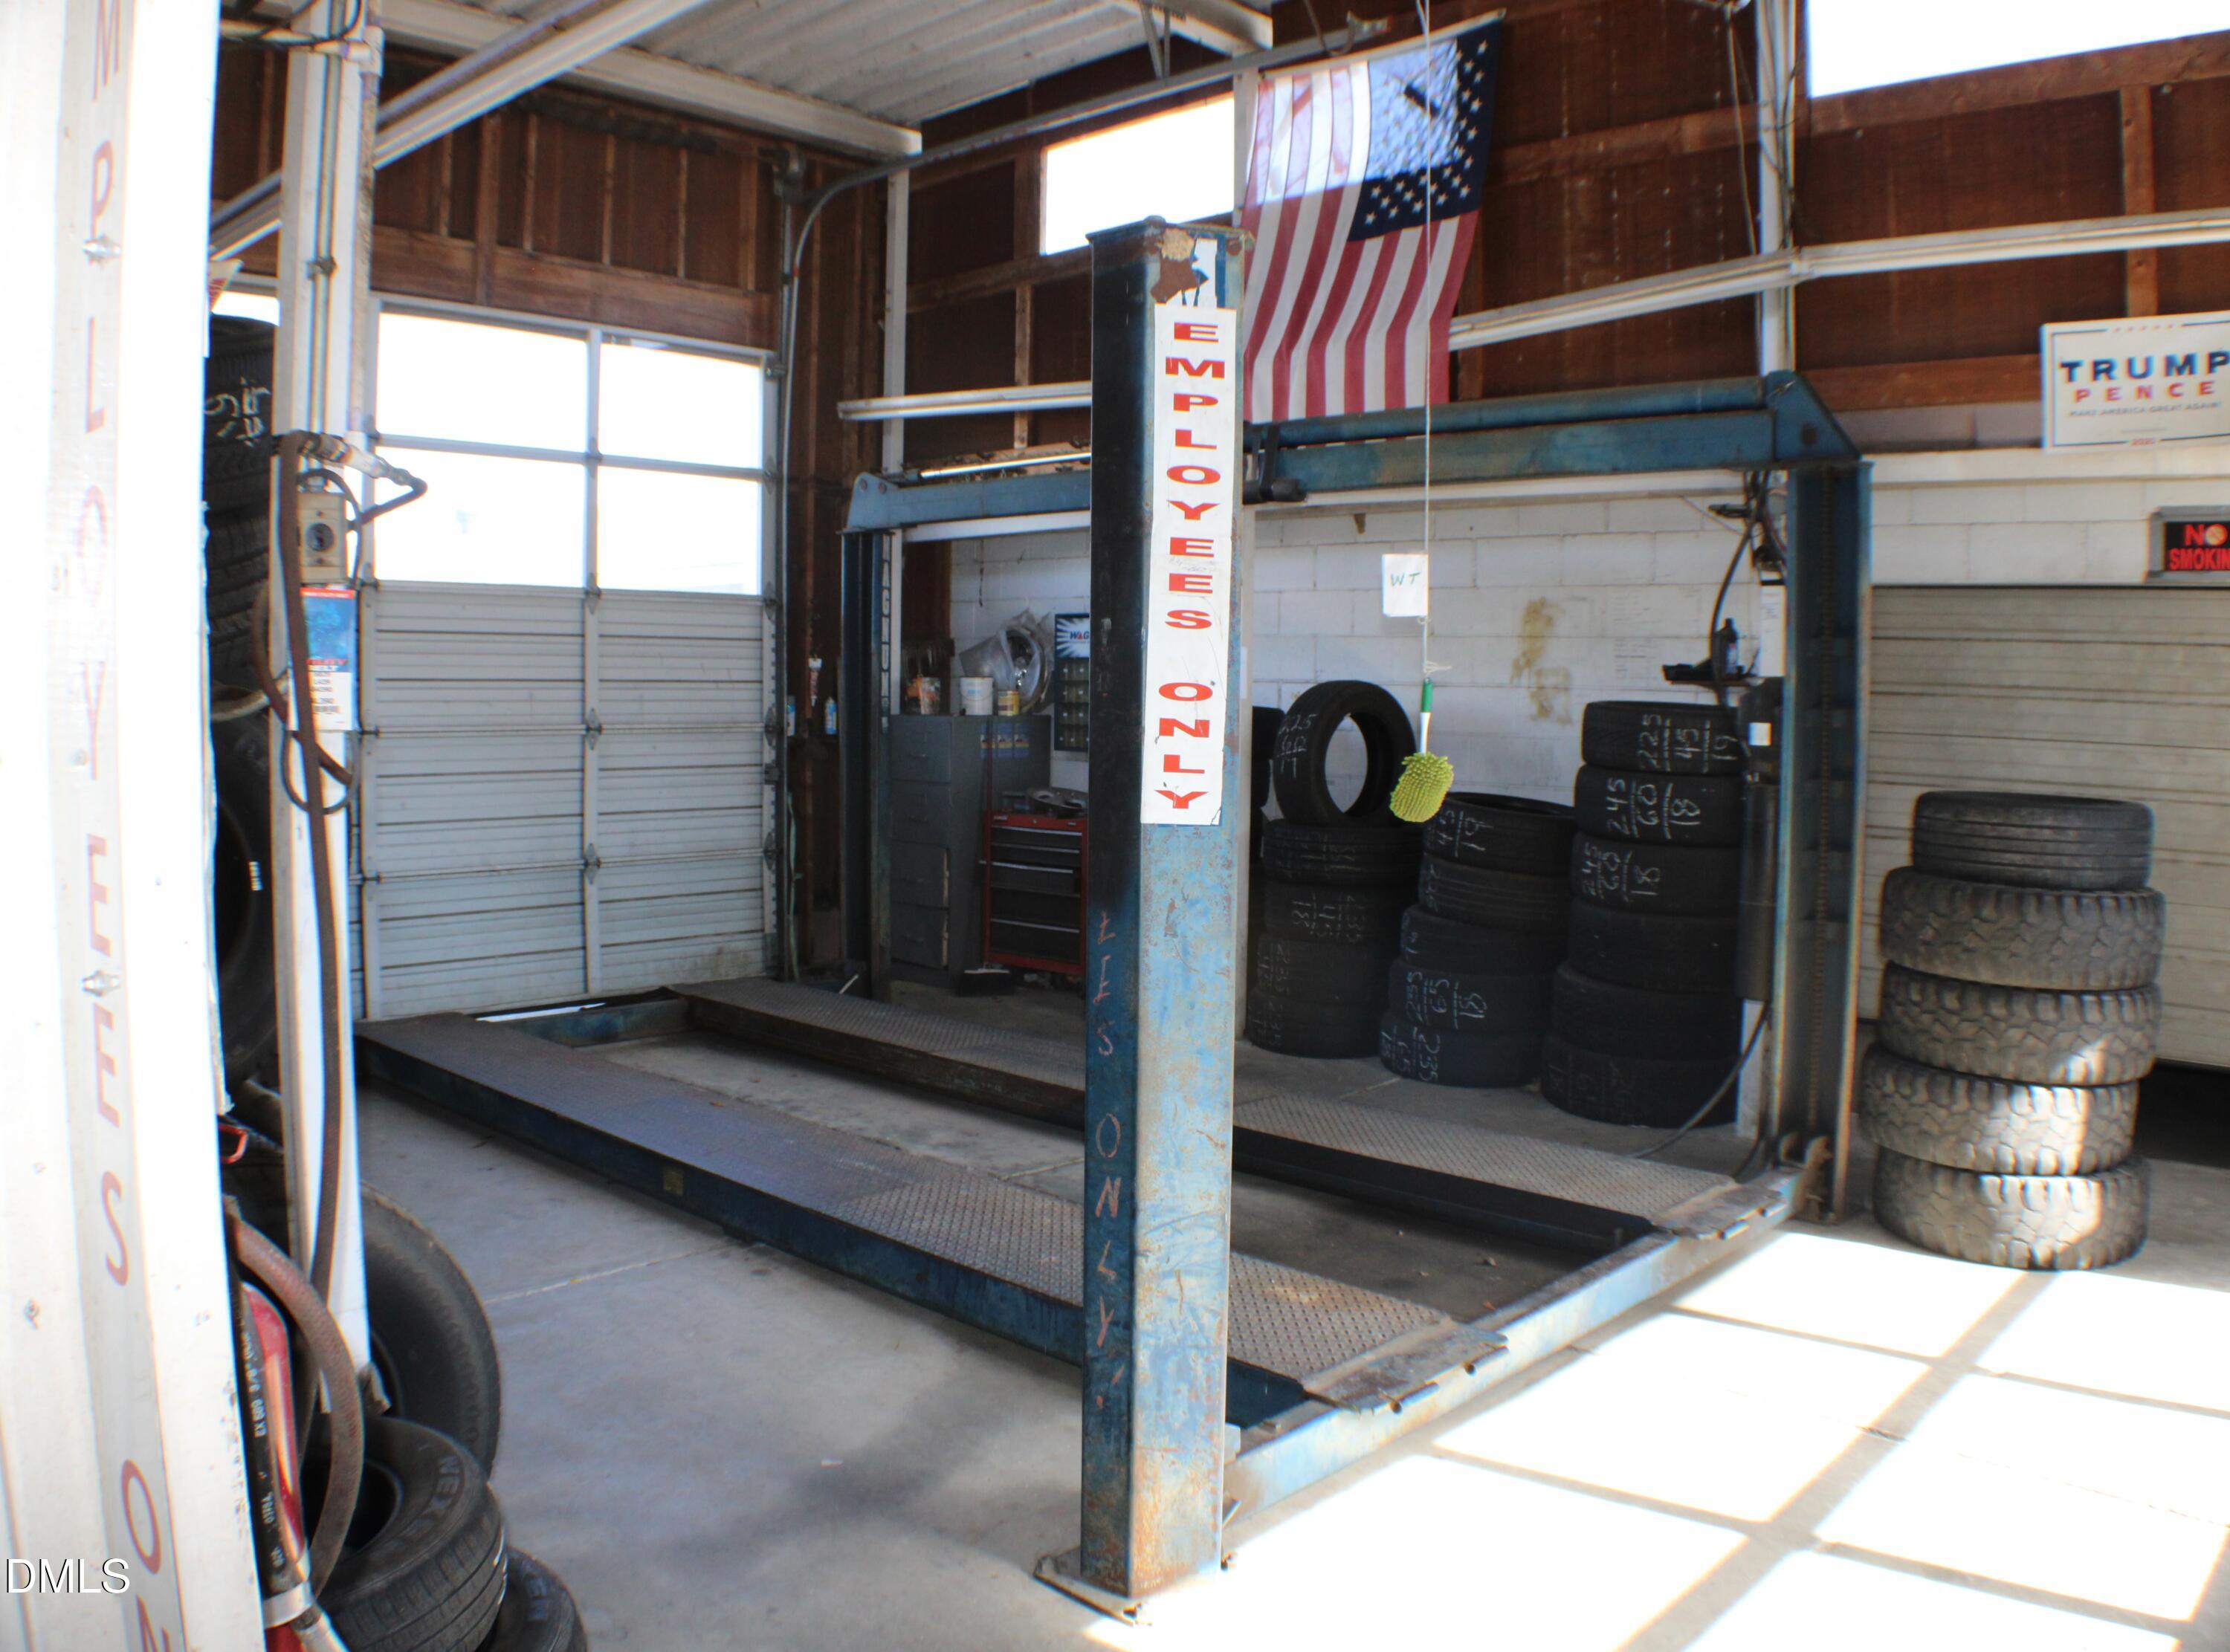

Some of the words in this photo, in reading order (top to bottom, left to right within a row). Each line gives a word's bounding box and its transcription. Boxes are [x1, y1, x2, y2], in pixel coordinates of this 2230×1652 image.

[2059, 350, 2230, 383] TRUMP
[2073, 380, 2215, 404] PENCE
[1165, 321, 1225, 630] EMPLOYEES
[2185, 523, 2228, 545] NO
[1155, 681, 1213, 810] ONLY
[1606, 777, 1631, 835] 245
[1670, 798, 1701, 826] 18
[1630, 864, 1661, 896] 18
